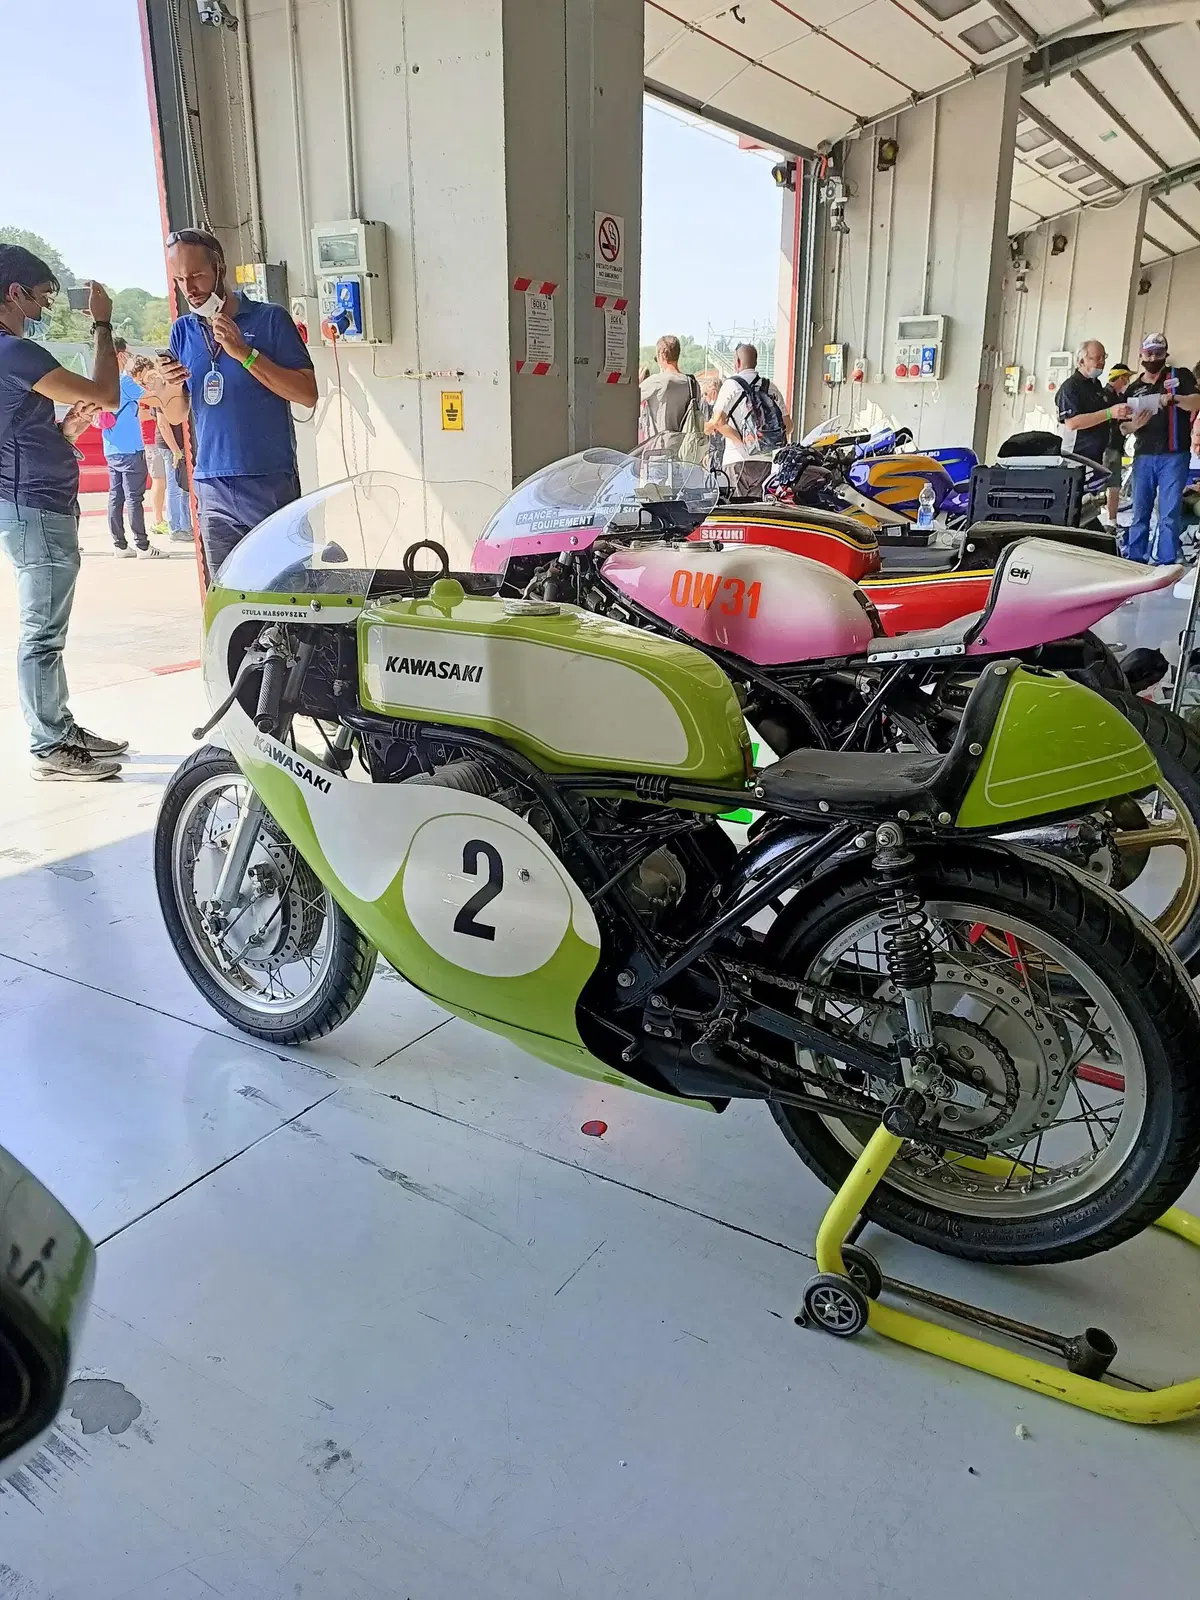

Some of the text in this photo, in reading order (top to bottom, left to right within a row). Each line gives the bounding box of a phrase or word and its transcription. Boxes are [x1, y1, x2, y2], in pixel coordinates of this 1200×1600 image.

[517, 510, 553, 523] FRANCE
[531, 515, 593, 530] EQUIPEMENT
[701, 530, 743, 540] SUZUKI
[1011, 567, 1030, 579] elf
[385, 656, 483, 683] KAWASAKI
[253, 735, 332, 794] KAWASAKI
[453, 839, 503, 941] 2
